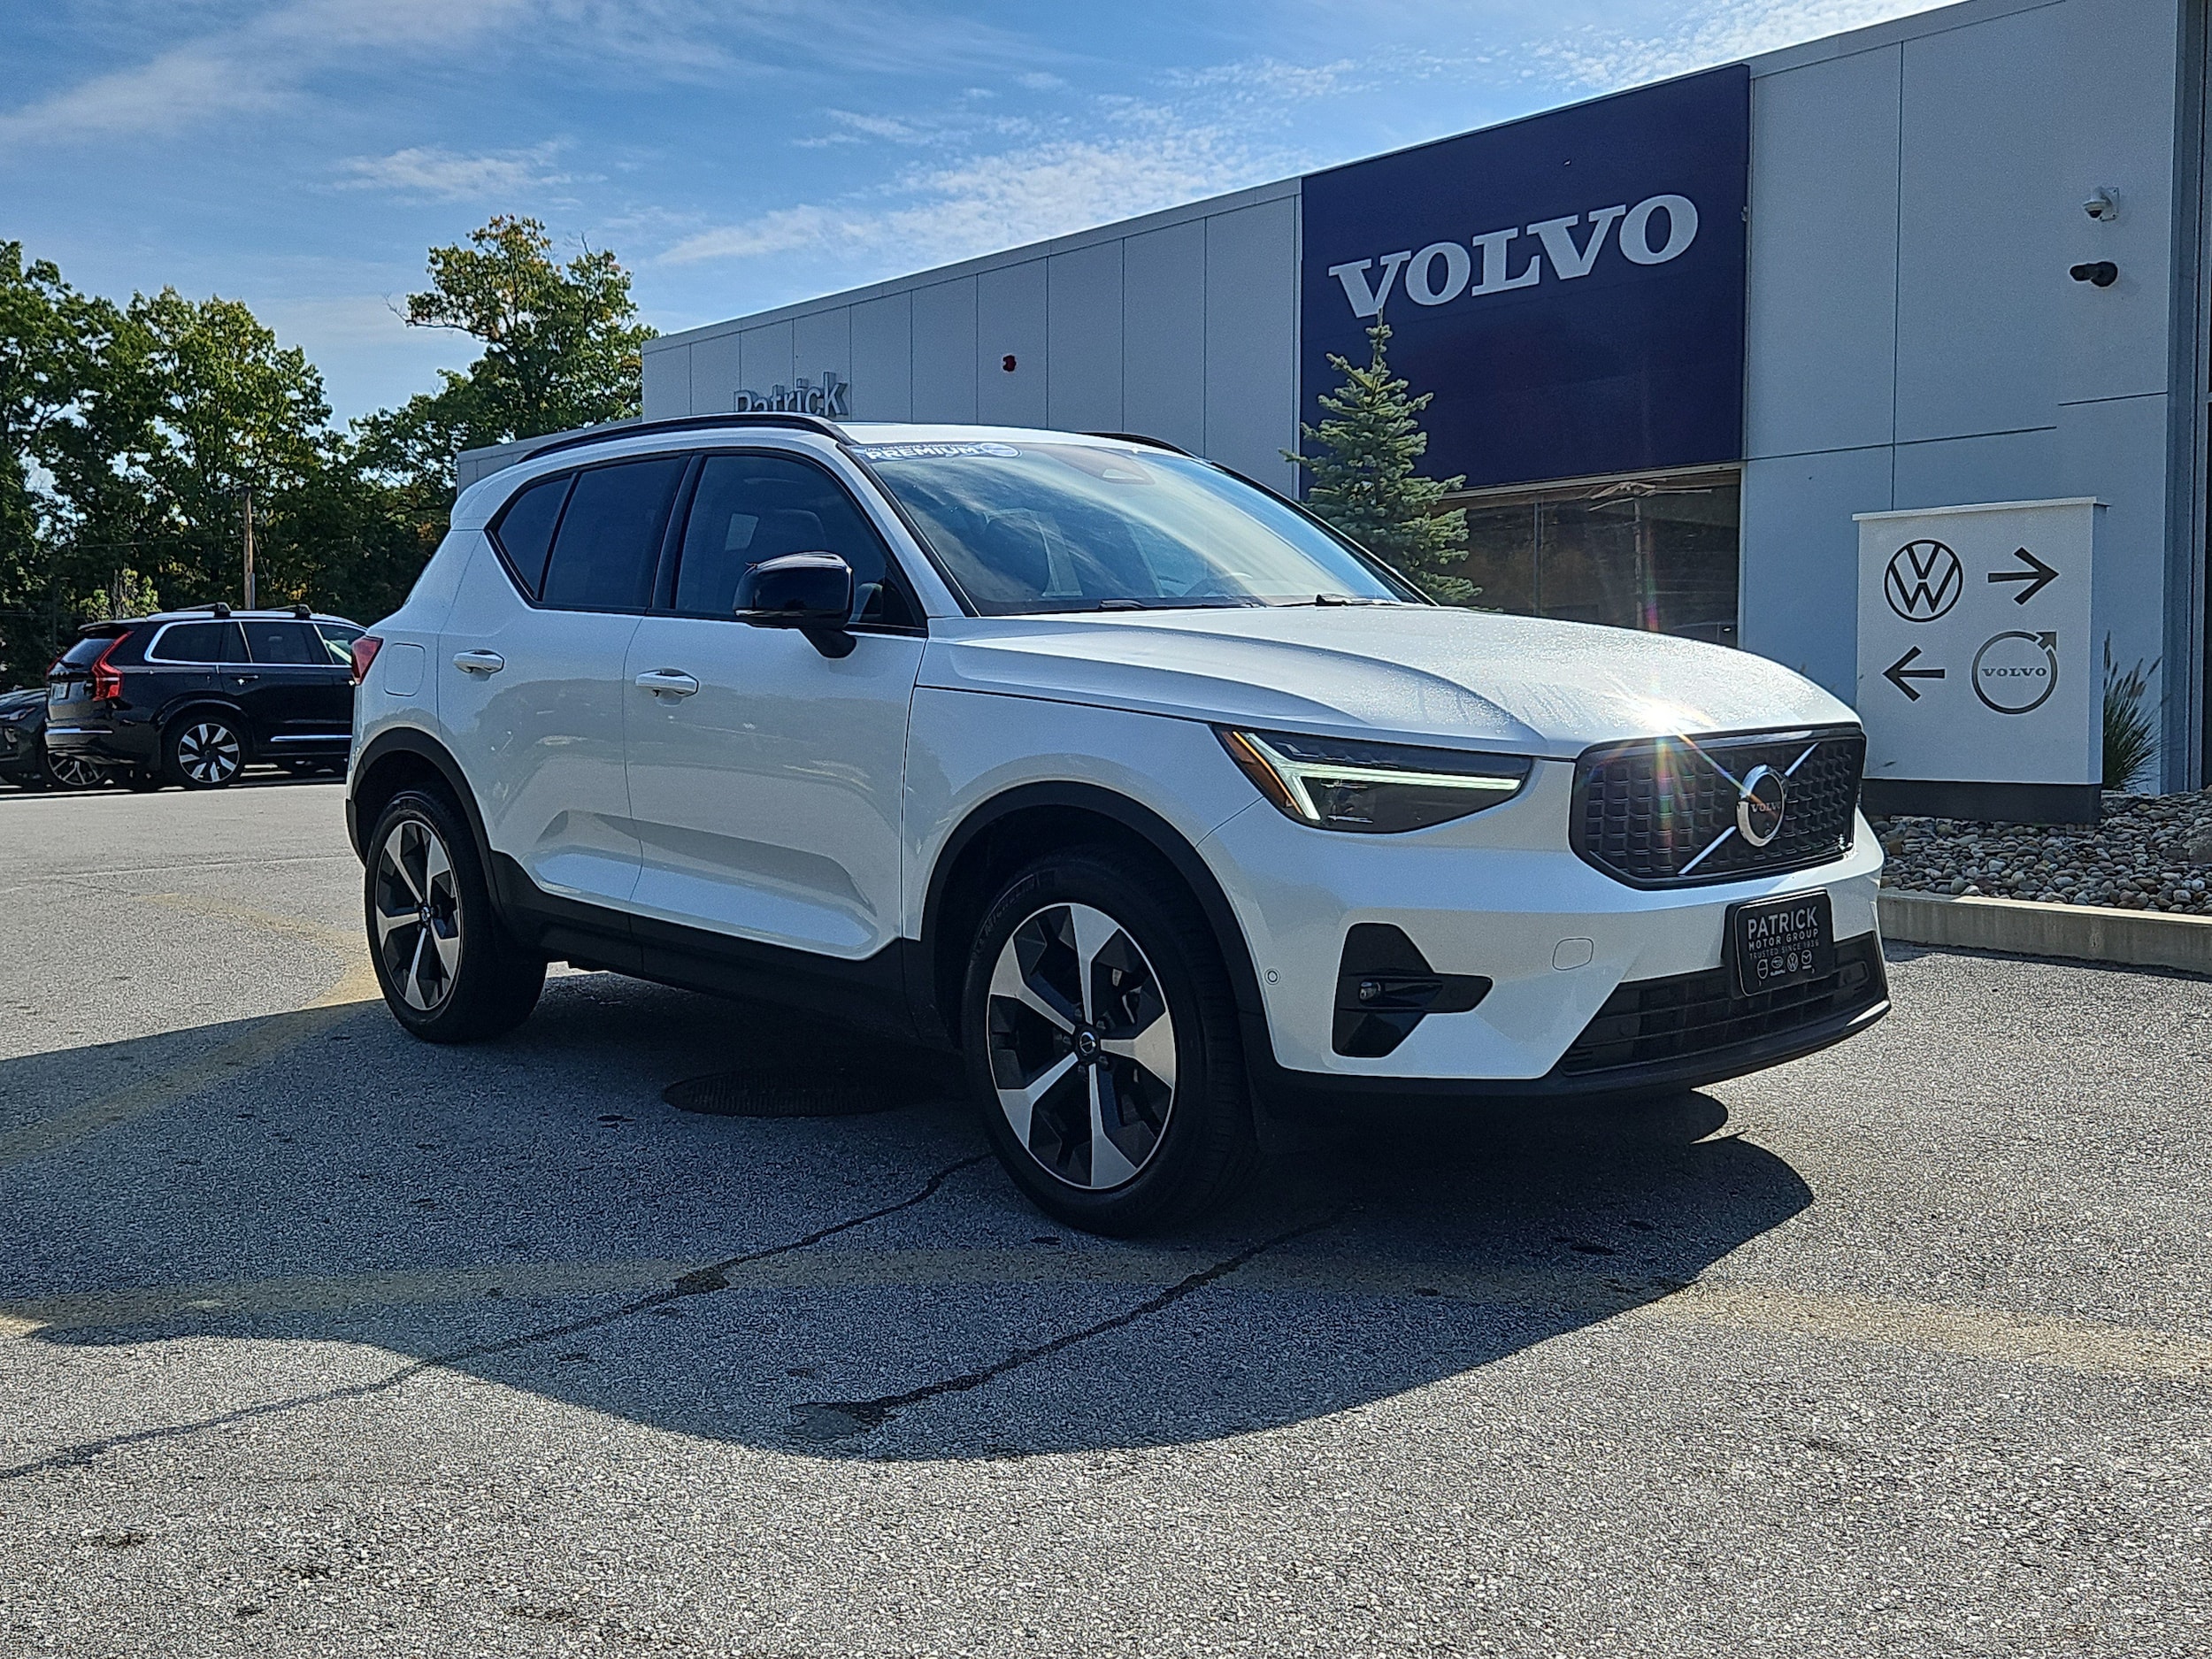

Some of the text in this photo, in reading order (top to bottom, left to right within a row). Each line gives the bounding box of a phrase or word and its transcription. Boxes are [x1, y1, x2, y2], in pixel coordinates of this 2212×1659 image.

[1329, 194, 1698, 318] VOLVO
[733, 371, 848, 416] Patrick
[865, 446, 979, 459] PREMIUM
[1982, 667, 2047, 677] VOLVO
[1747, 906, 1818, 940] PATRICK
[1748, 928, 1819, 951] MOTOR GROUP
[1749, 948, 1778, 960] TRUSTED
[1781, 942, 1801, 954] SINCE
